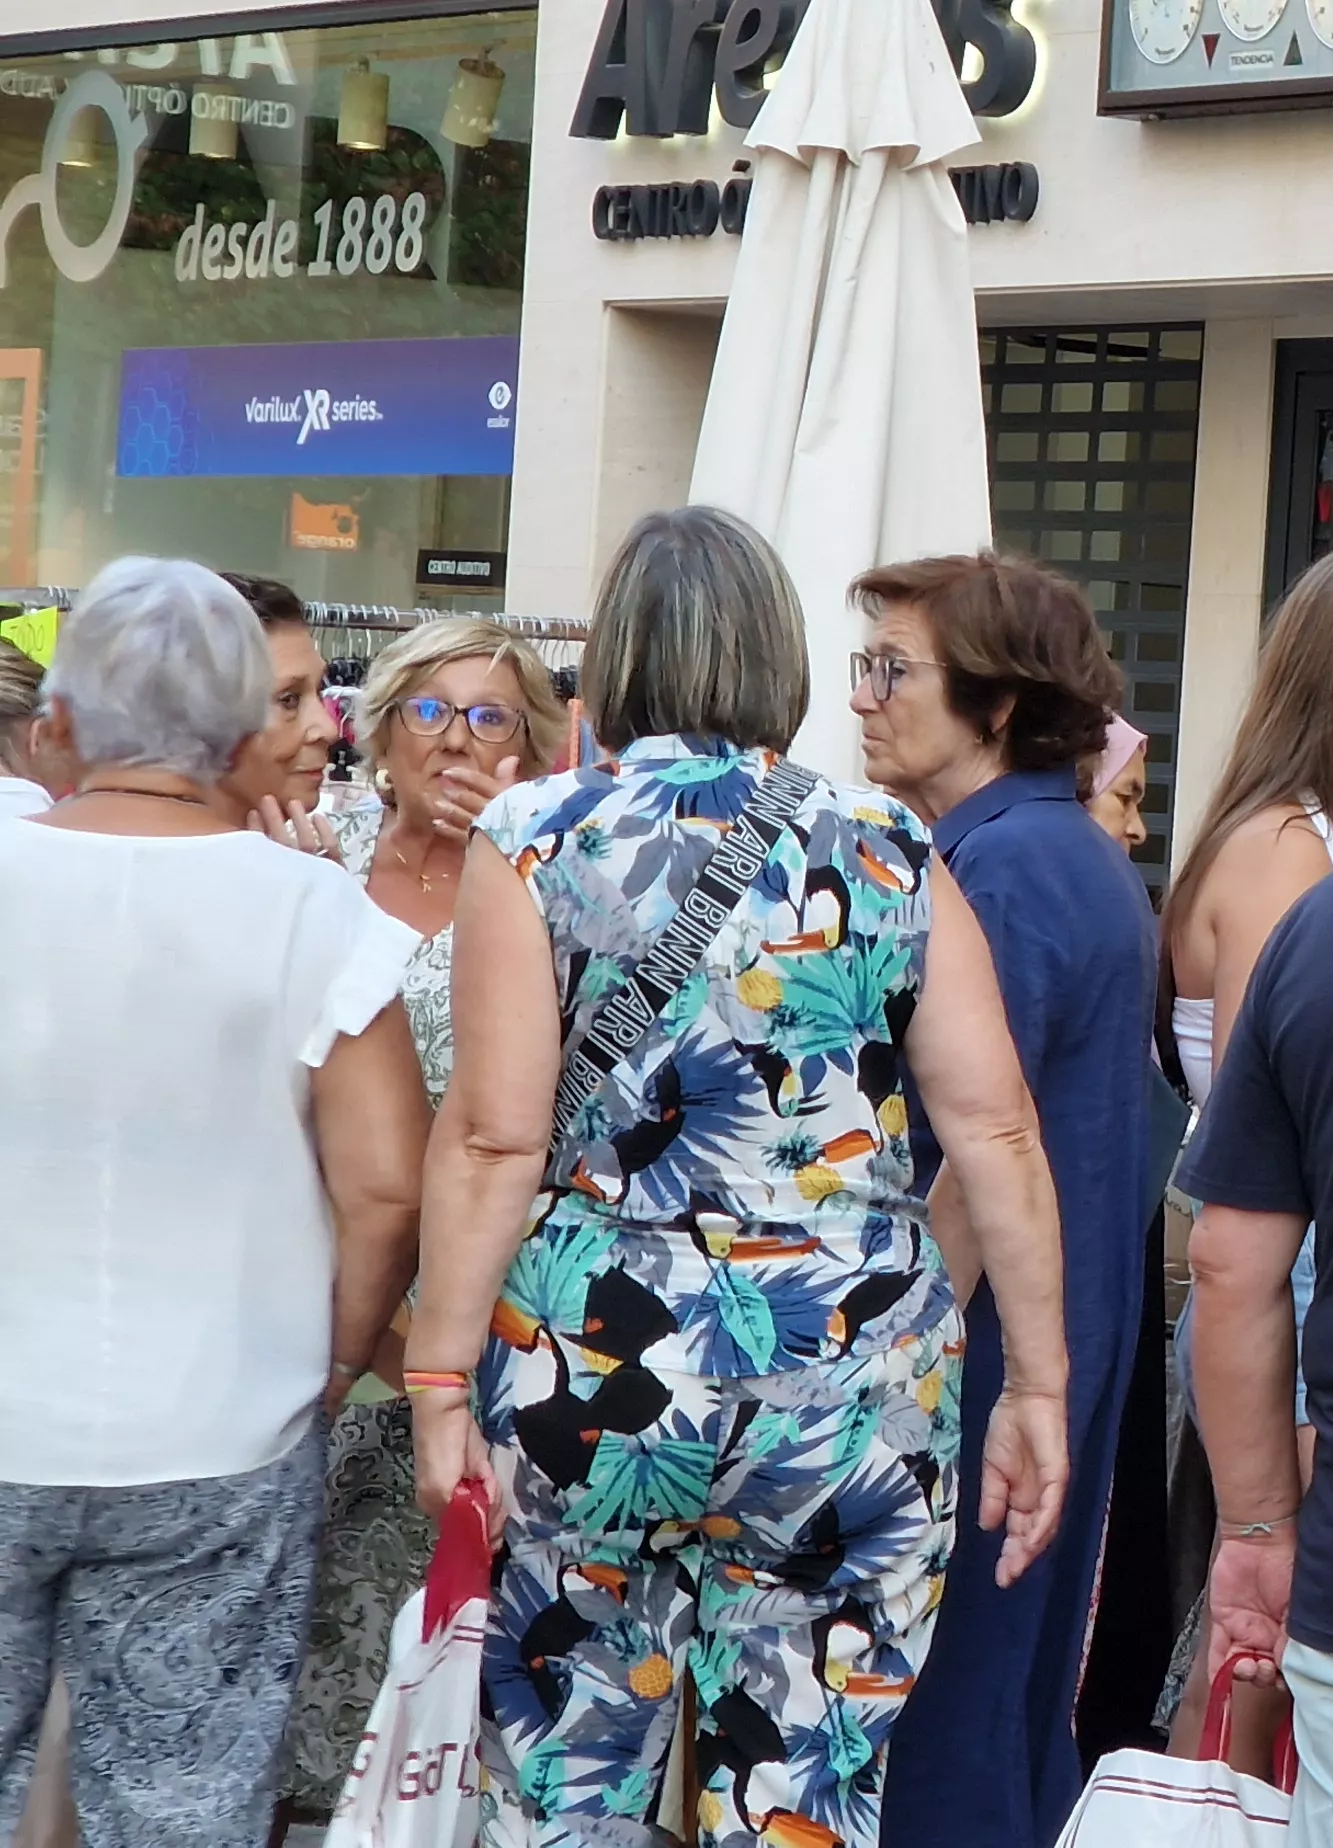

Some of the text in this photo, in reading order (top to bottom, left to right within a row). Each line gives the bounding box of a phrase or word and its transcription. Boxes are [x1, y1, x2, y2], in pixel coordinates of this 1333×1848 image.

[1230, 54, 1275, 67] TENDENCIA
[175, 192, 426, 281] desde 1888
[592, 179, 720, 241] CENTRO
